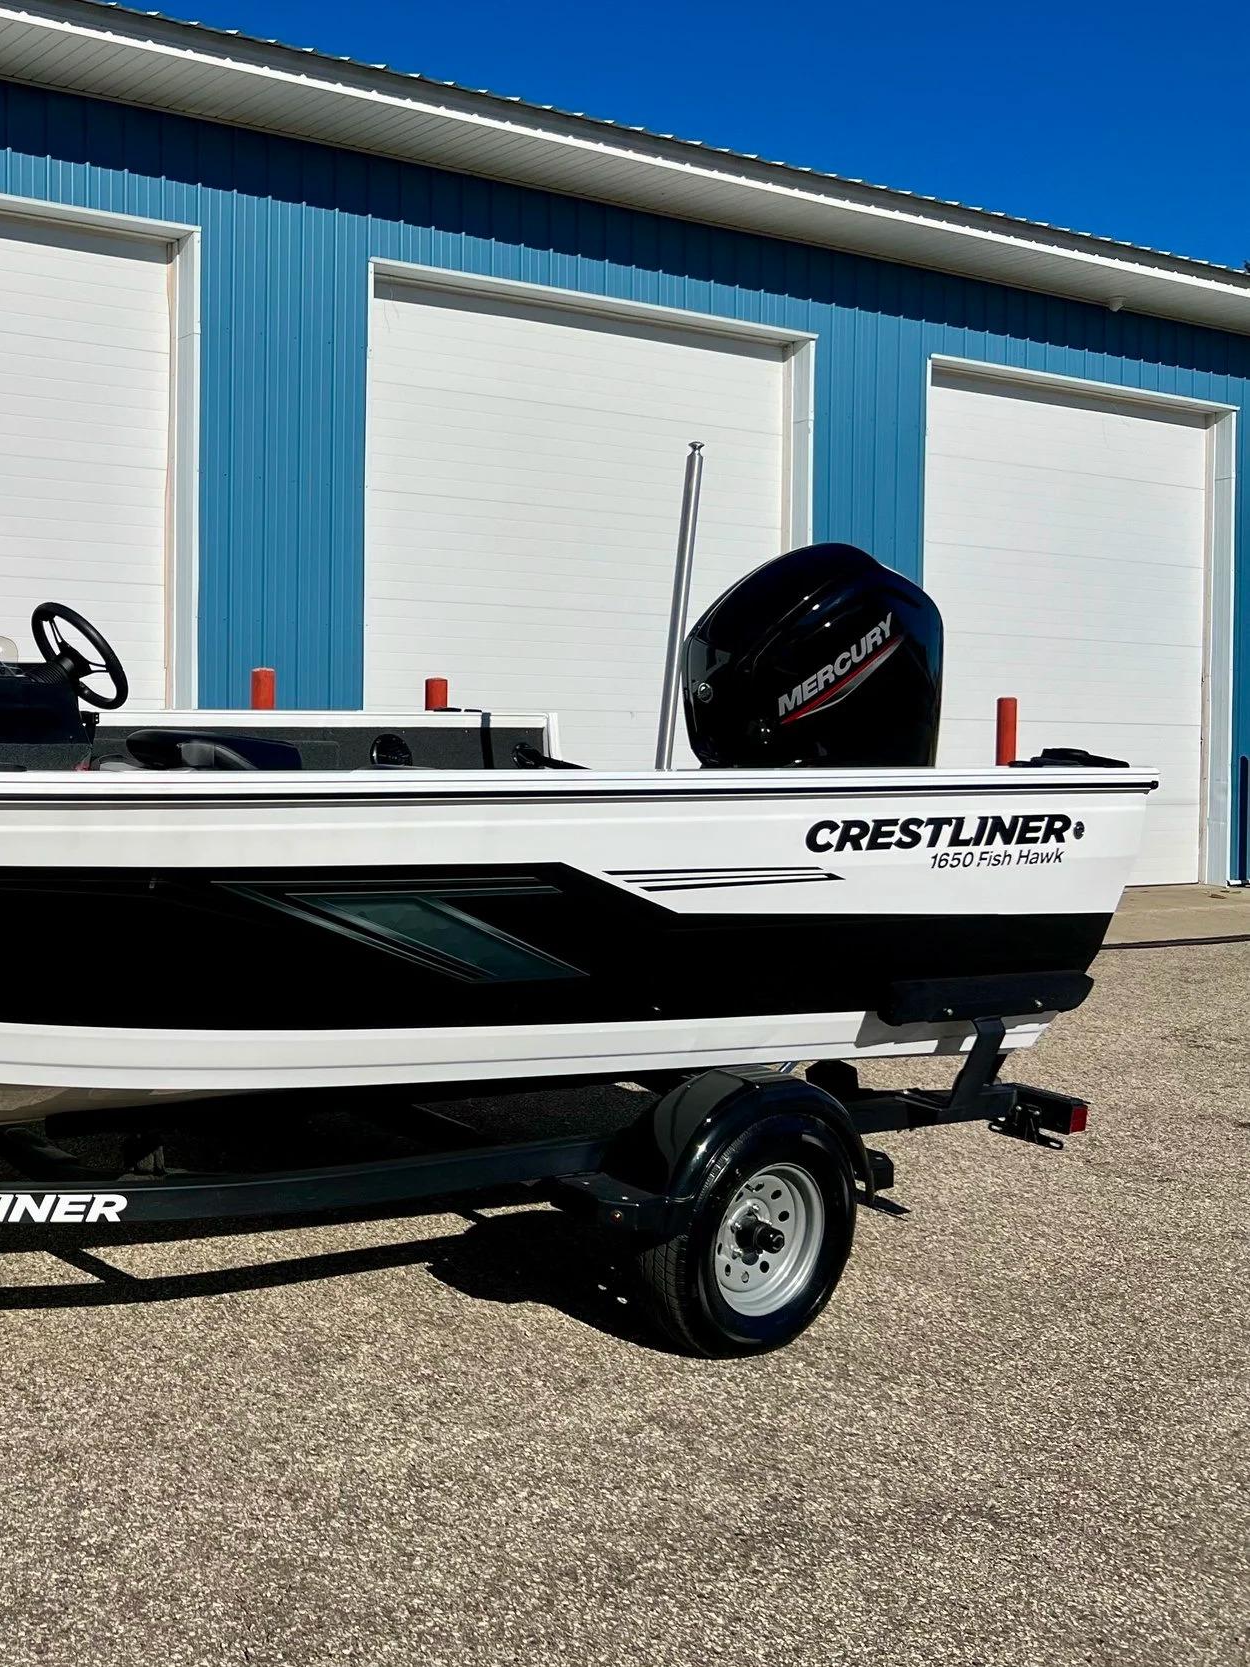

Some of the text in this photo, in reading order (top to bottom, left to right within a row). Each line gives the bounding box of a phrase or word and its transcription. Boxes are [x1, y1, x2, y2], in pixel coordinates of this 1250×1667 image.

[778, 612, 892, 717] MERCURY
[805, 813, 1072, 853] CRESTLINER
[930, 847, 1066, 869] 1650 Fish Hawk
